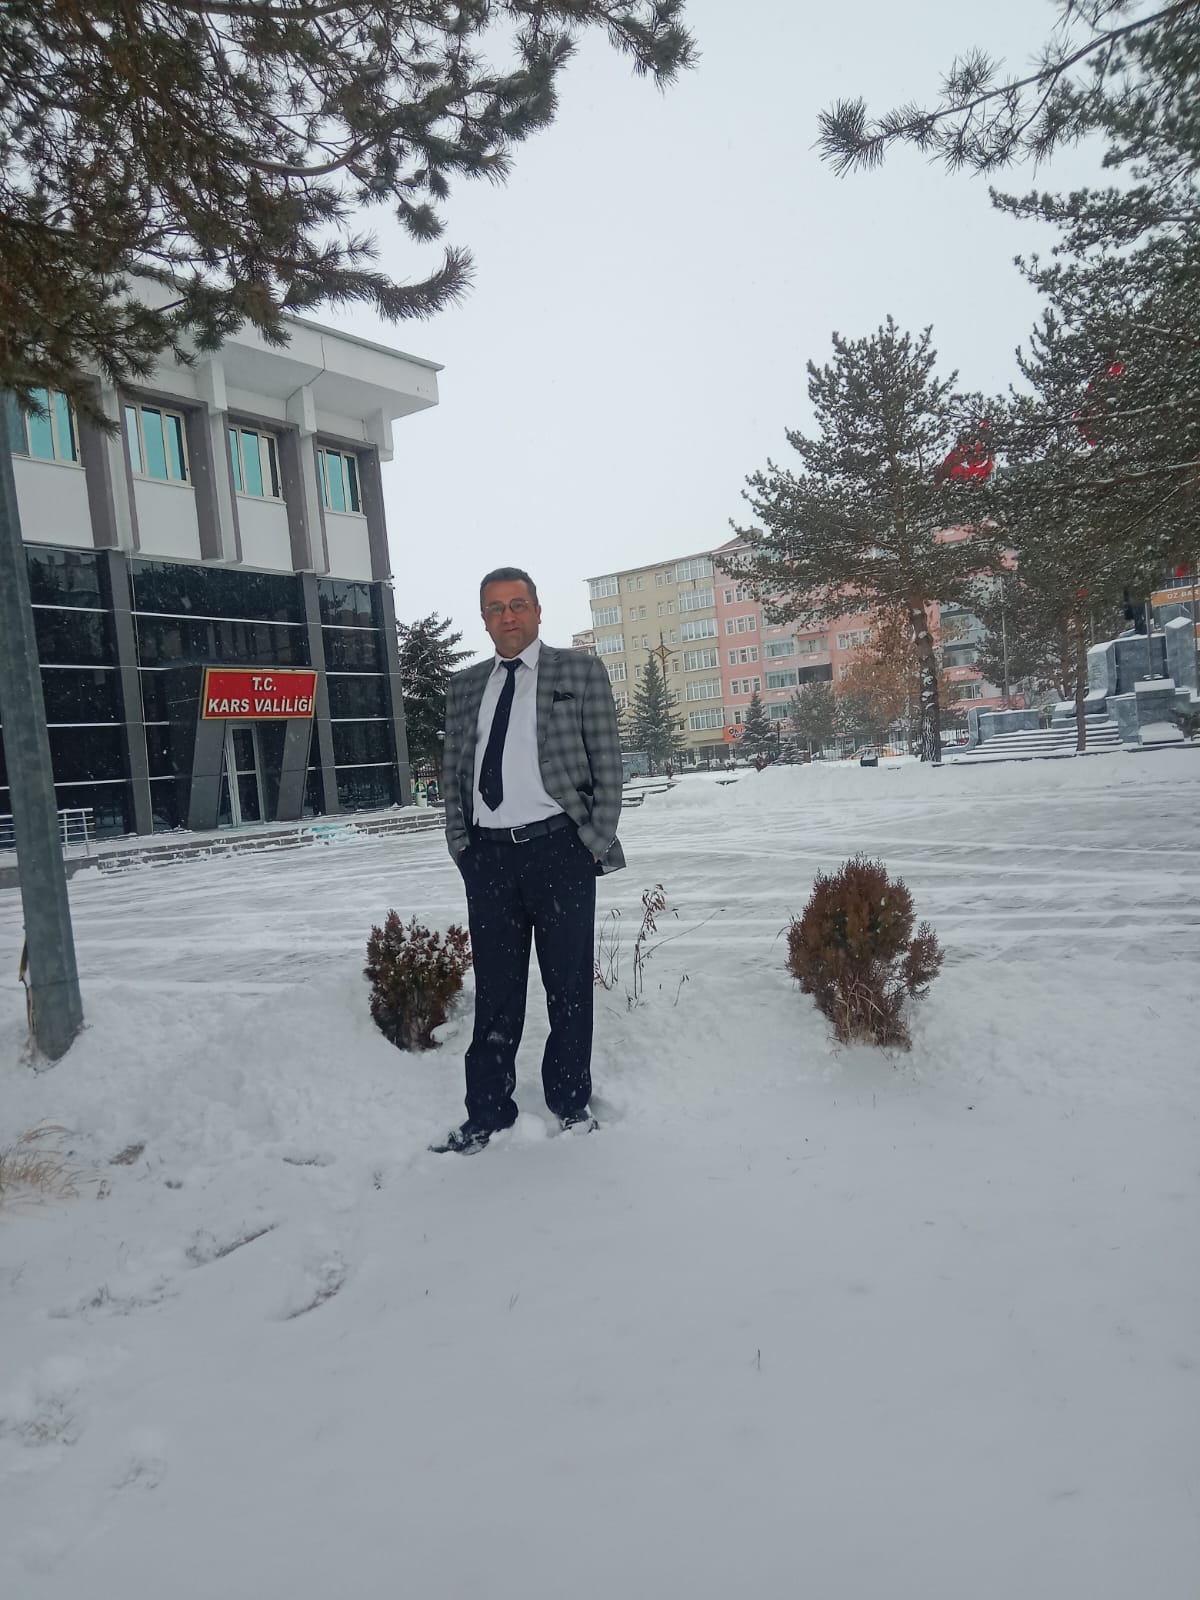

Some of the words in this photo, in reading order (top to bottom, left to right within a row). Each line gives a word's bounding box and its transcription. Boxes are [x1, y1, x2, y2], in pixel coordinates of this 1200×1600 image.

[252, 677, 277, 691] T.C.
[208, 699, 249, 712] KARS
[255, 696, 312, 712] VALİLİĞİ
